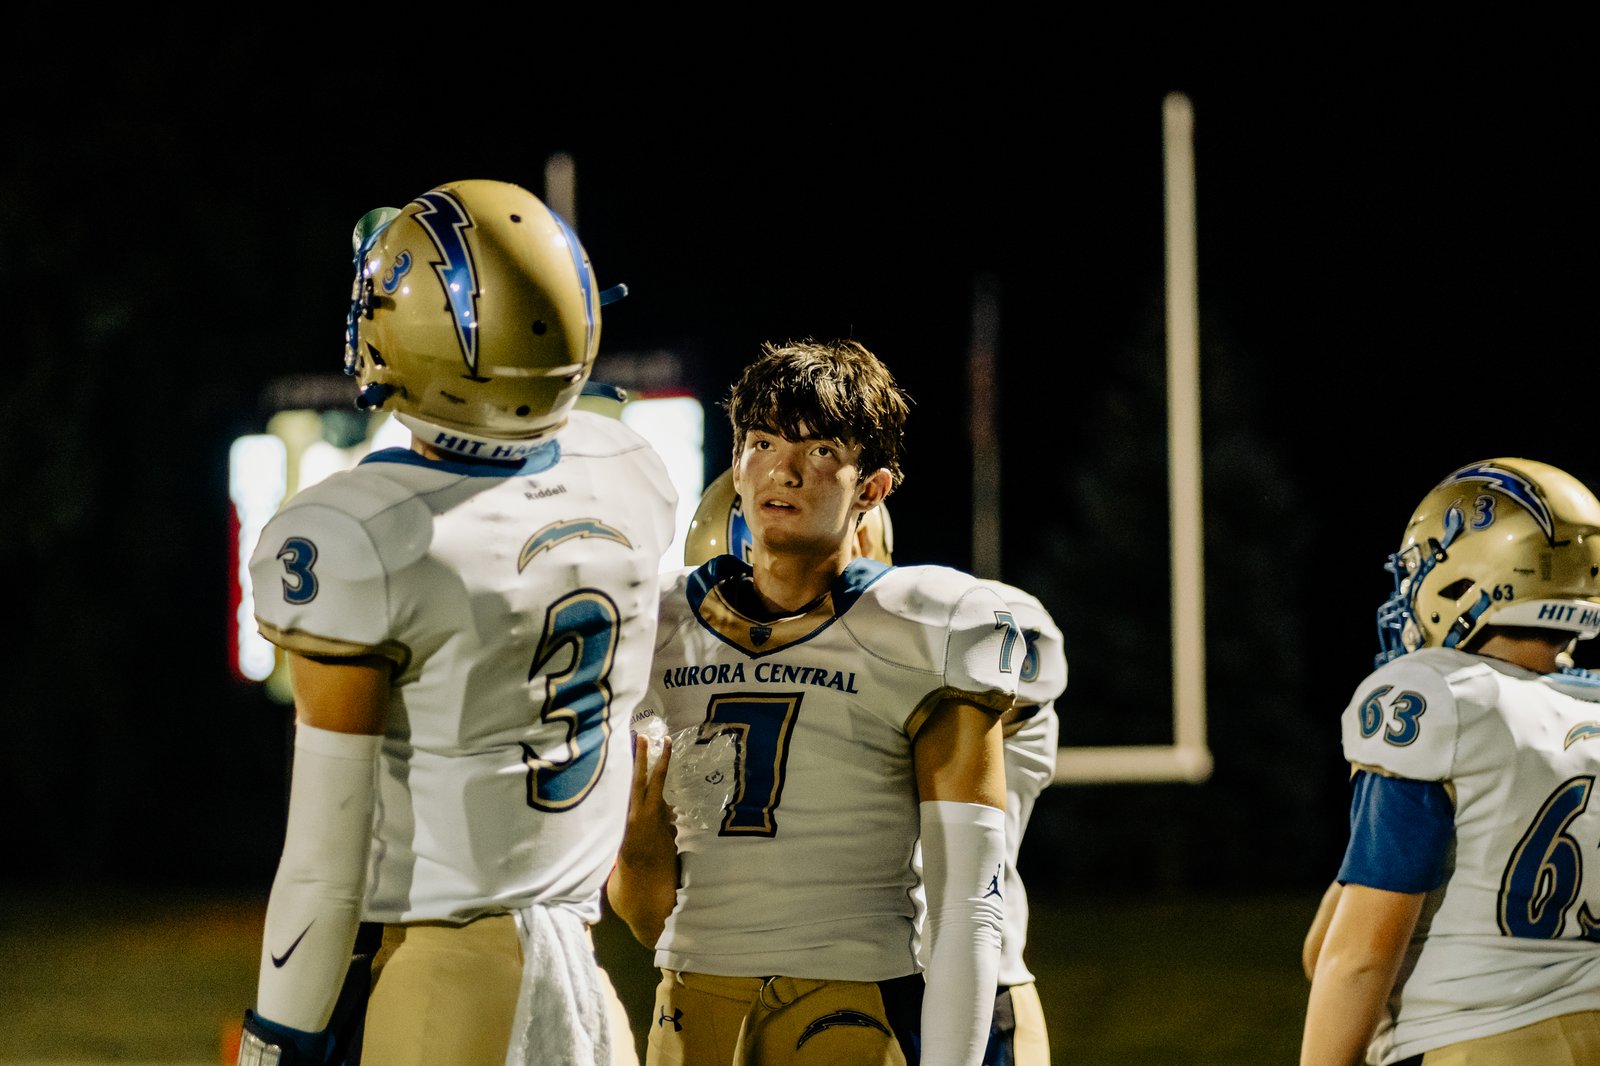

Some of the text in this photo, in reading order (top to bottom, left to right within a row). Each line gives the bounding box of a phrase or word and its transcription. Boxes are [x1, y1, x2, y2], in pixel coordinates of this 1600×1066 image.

[382, 249, 413, 295] 3
[434, 432, 488, 455] HIT
[524, 484, 567, 501] Riddell
[277, 537, 319, 604] 3
[1492, 584, 1514, 601] 63
[993, 610, 1020, 674] 7
[1538, 603, 1600, 627] HIT HA
[519, 587, 621, 814] 3
[663, 662, 859, 694] AURORA CENTRAL
[1358, 684, 1427, 748] 63
[696, 691, 806, 838] 7
[1496, 774, 1600, 942] 6
